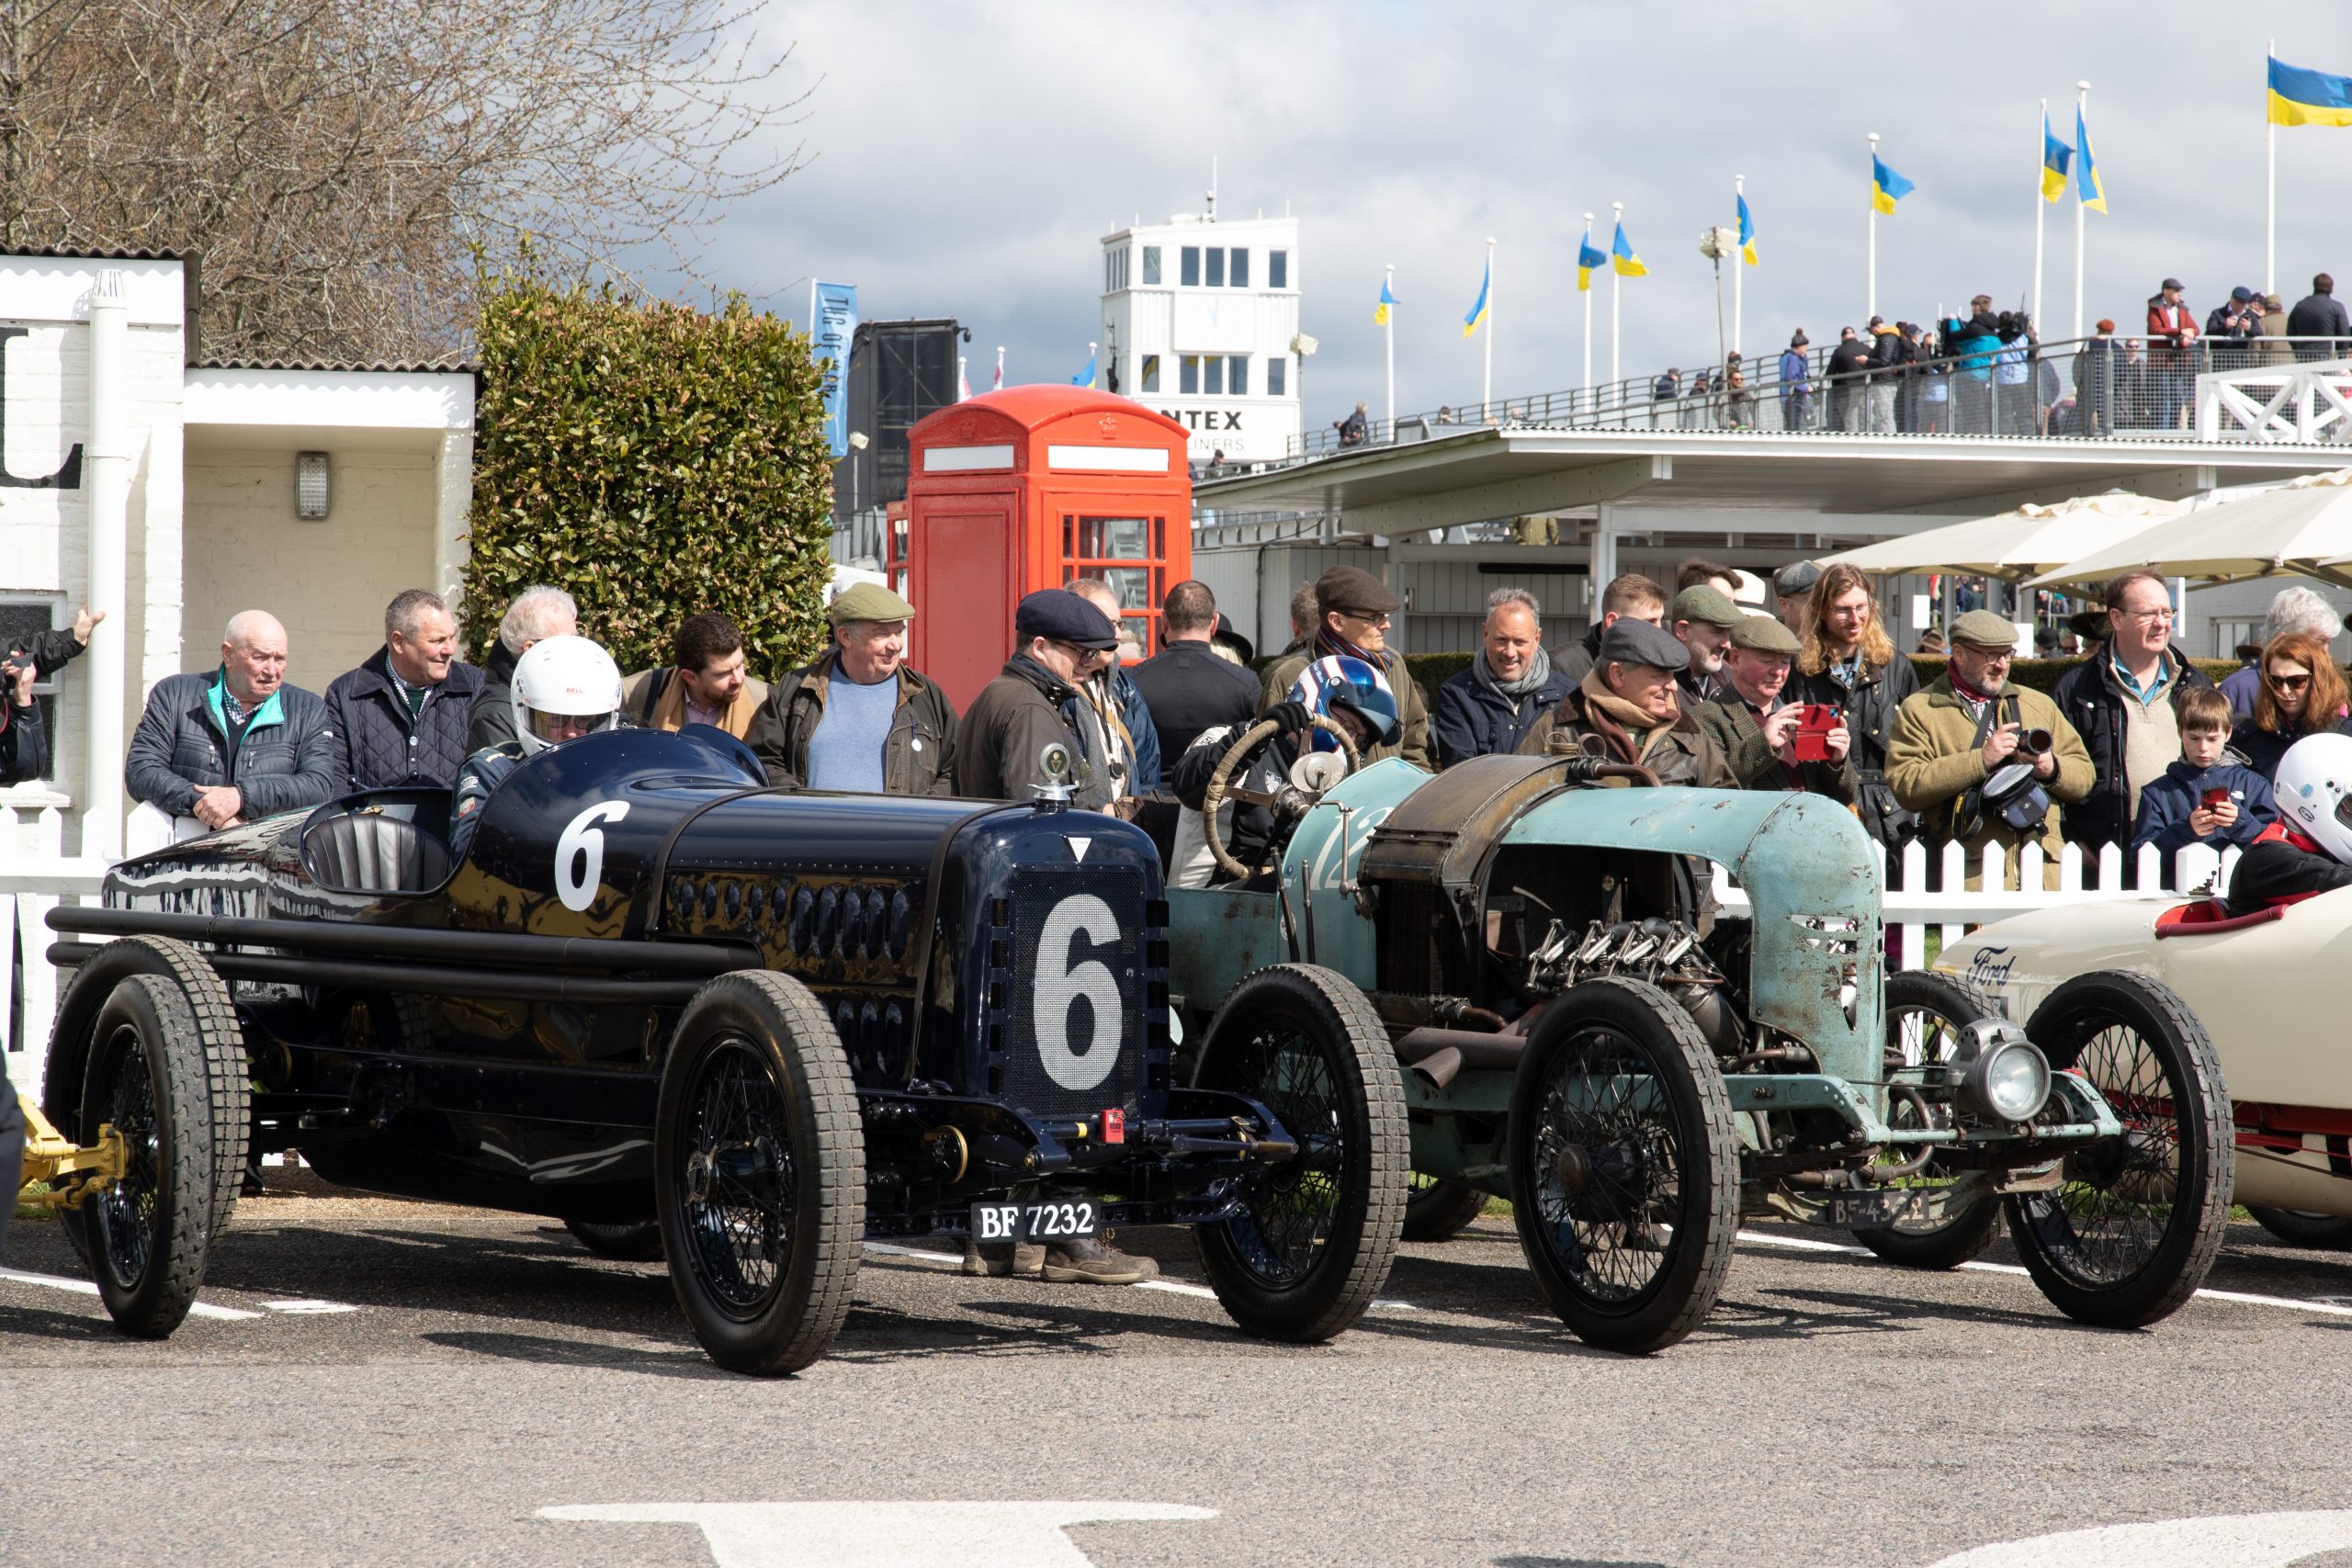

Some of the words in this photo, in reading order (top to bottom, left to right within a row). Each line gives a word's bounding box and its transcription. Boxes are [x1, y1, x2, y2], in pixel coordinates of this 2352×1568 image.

[822, 298, 849, 325] TUG
[821, 333, 842, 351] OF
[1186, 438, 1245, 451] INERS
[554, 799, 631, 912] 6
[1310, 805, 1396, 891] 12
[1966, 946, 2017, 987] Ford
[1033, 893, 1123, 1090] 6
[979, 1206, 1019, 1238] BF
[1025, 1202, 1094, 1235] 7232
